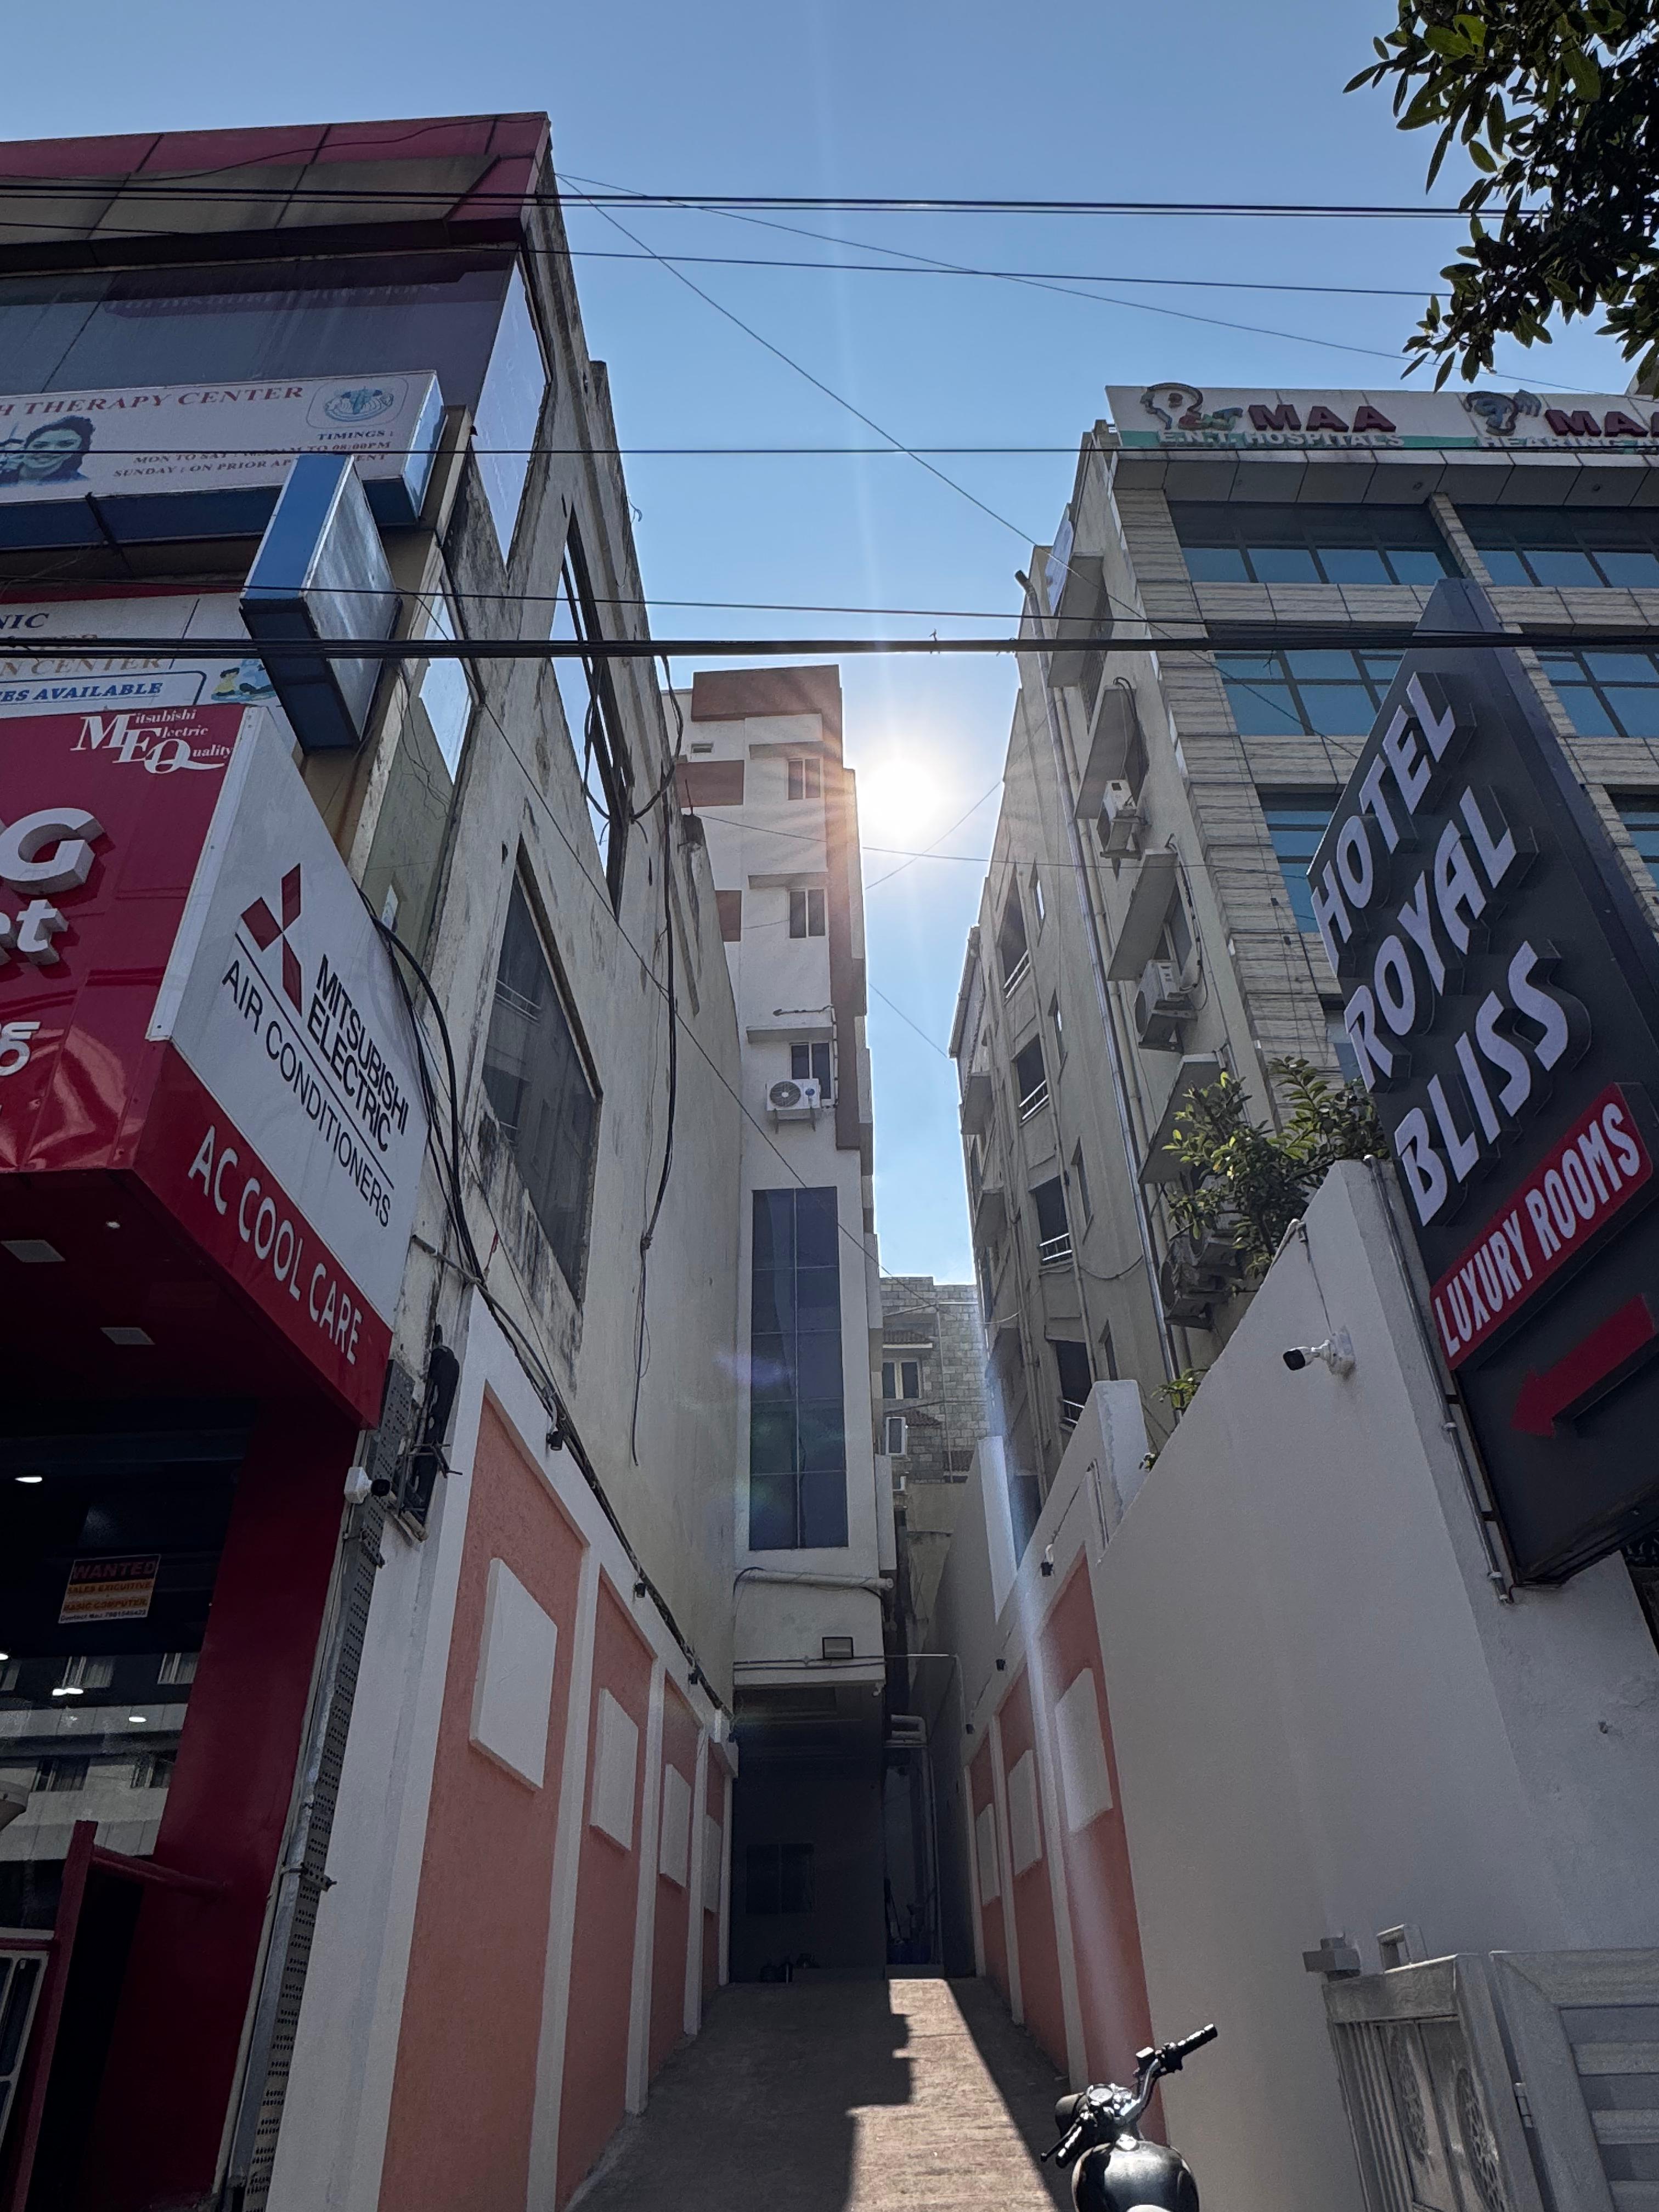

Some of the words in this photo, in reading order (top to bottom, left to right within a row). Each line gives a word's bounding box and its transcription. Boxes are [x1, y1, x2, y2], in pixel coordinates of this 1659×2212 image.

[25, 394, 172, 415] THERAPY
[177, 386, 304, 405] CENTER
[317, 429, 386, 441] TIMINGS
[1248, 404, 1397, 432] MAA
[1545, 409, 1659, 438] MA
[1159, 430, 1237, 446] E.N.T.
[1243, 432, 1404, 447] HOSPITALS
[113, 466, 177, 478] SUNDAY
[216, 461, 267, 471] PRIOR
[31, 658, 162, 675] CENTER
[0, 690, 30, 702] ES
[32, 682, 163, 700] AVAILABLE
[1311, 671, 1456, 979] HOTEL
[1344, 786, 1517, 1094] ROYAL
[316, 953, 409, 1136] MITSUBISHI
[307, 992, 392, 1152] ELECTRIC
[1394, 940, 1569, 1227] BLISS
[222, 960, 263, 1034] AIR
[266, 1020, 391, 1227] CONDITIONERS
[188, 1125, 239, 1215] AC
[238, 1177, 303, 1301] COOL
[309, 1263, 363, 1365] CARE
[1434, 1209, 1533, 1358] LUXURY
[1525, 1102, 1641, 1261] ROOMS
[72, 1560, 156, 1580] WANTED
[64, 1601, 92, 1611] BASIC
[94, 1598, 148, 1609] COMPUTER
